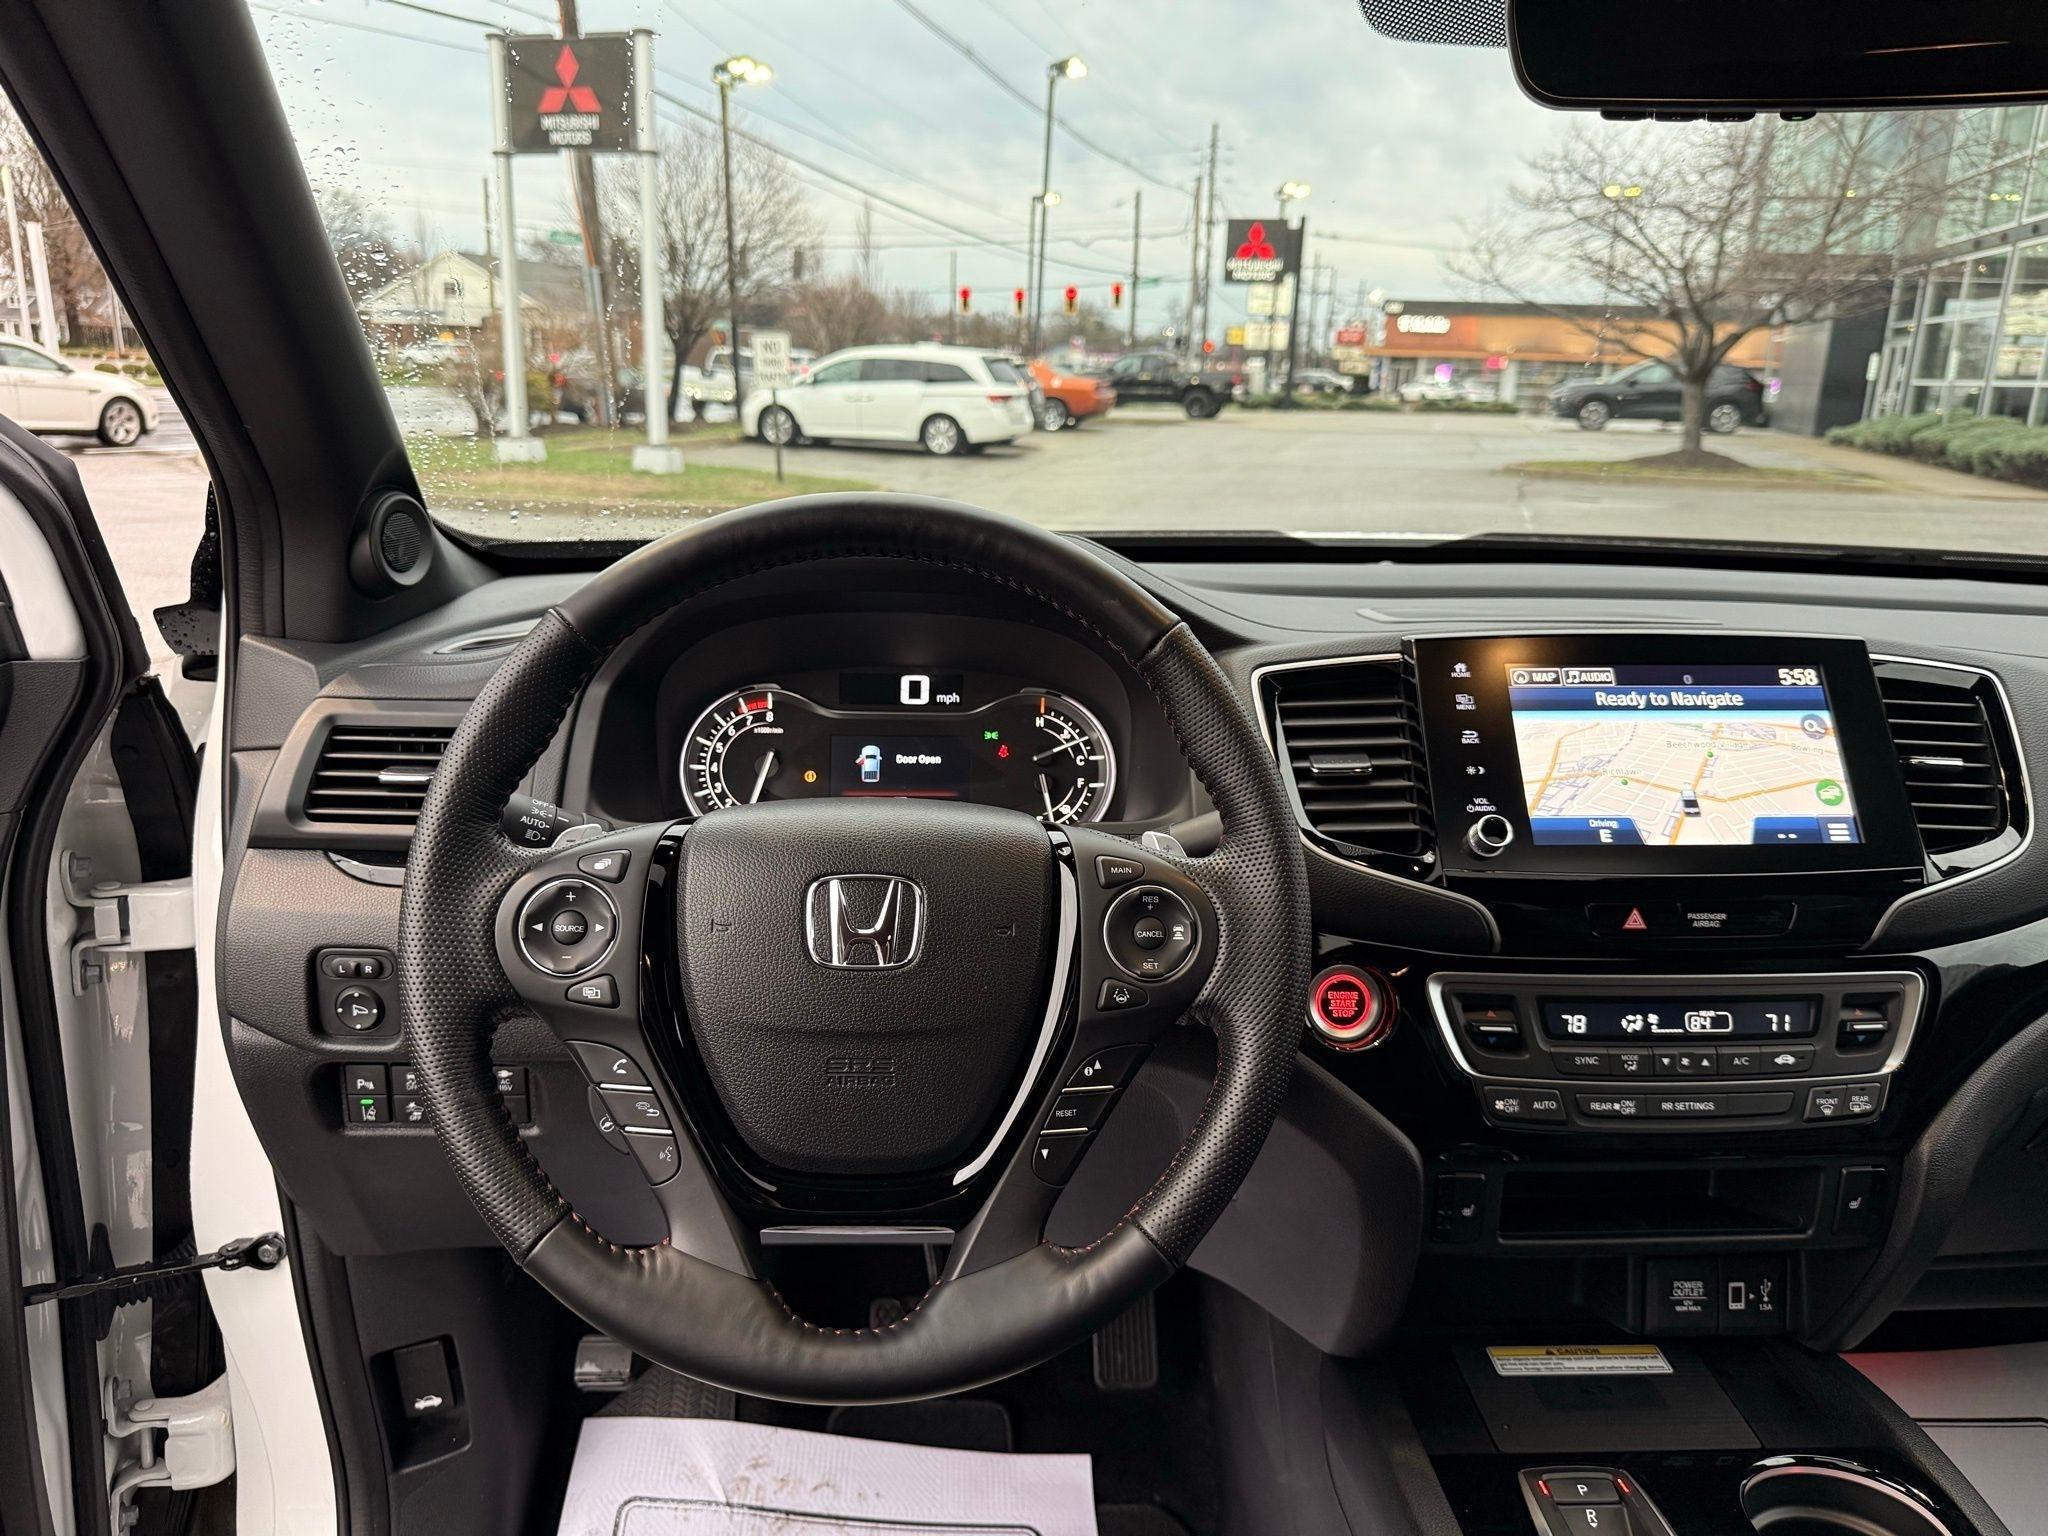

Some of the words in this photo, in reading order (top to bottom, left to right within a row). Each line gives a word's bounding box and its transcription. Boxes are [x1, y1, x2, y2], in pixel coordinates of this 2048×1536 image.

[1532, 672, 1556, 682] MAP
[1581, 671, 1612, 682] AUDIO
[1778, 668, 1819, 686] 5:58
[900, 674, 930, 705] 0
[936, 692, 960, 704] mph
[1595, 691, 1647, 709] Ready
[1649, 692, 1669, 706] to
[1670, 691, 1744, 709] Navigate
[745, 715, 753, 727] 7
[765, 711, 774, 723] 8
[1035, 717, 1045, 728] H
[728, 727, 736, 737] 6
[715, 743, 724, 754] 5
[896, 754, 917, 765] Door
[918, 754, 942, 766] Open
[1076, 755, 1085, 766] C
[710, 763, 719, 774] 4
[1077, 777, 1085, 788] F
[714, 783, 722, 793] 3
[532, 799, 549, 807] OFF
[1475, 804, 1497, 812] AUDIO
[520, 815, 546, 829] AUTO
[1589, 819, 1619, 829] Driving
[1600, 829, 1613, 843] E
[1110, 866, 1132, 874] MAIN
[1687, 912, 1727, 920] PASSENGER
[1692, 920, 1720, 928] AIRBAG
[554, 925, 584, 933] SOURCE
[339, 965, 346, 973] L
[1327, 991, 1359, 1000] ENGINE
[1330, 1000, 1357, 1008] START
[1332, 1009, 1354, 1017] STOP
[1561, 1014, 1588, 1034] 78
[1765, 1013, 1791, 1032] 71
[1574, 1056, 1600, 1065] SYNC
[1733, 1057, 1750, 1065] A/C
[1504, 1098, 1519, 1107] ON/
[1533, 1101, 1556, 1110] AUTO
[1590, 1102, 1612, 1111] REAR
[1620, 1100, 1636, 1108] ON/
[1661, 1102, 1674, 1111] RR
[1675, 1102, 1715, 1111] SETTINGS
[1055, 1109, 1077, 1117] RESET
[1620, 1107, 1636, 1115] OFF
[1673, 1281, 1703, 1289] POWER
[1672, 1288, 1704, 1296] OUTLET
[1557, 1347, 1600, 1355] CAUTION
[1577, 1484, 1588, 1496] P
[1586, 1509, 1598, 1523] R
